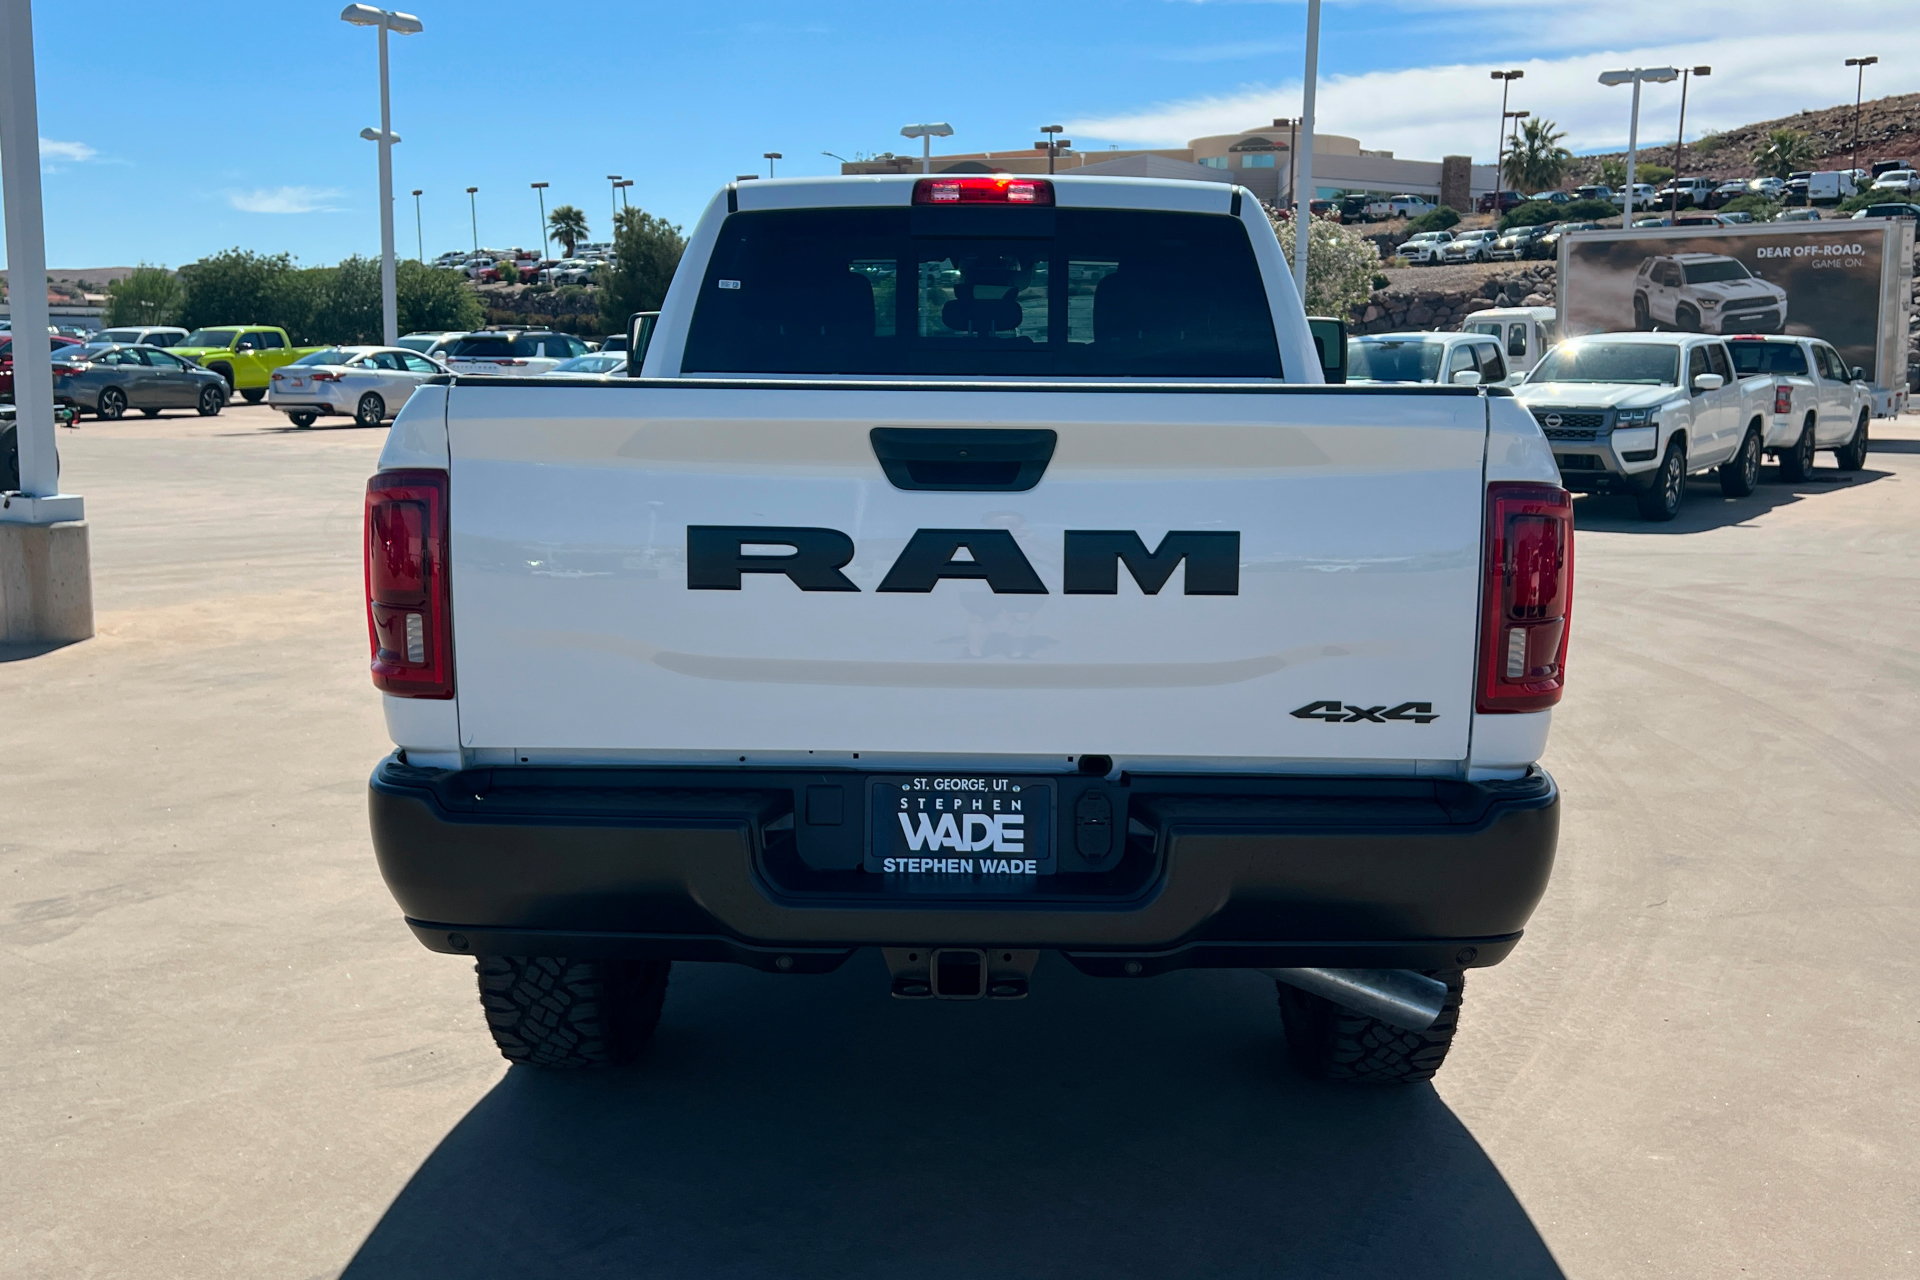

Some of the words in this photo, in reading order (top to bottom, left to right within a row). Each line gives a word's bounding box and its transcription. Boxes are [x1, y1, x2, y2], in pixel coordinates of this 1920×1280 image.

[1757, 247, 1791, 258] DEAR
[1793, 244, 1865, 257] OFF-ROAD,
[1811, 259, 1841, 269] GAME
[687, 525, 1240, 595] RAM
[1289, 700, 1440, 723] 4x4
[913, 778, 930, 790] ST.
[933, 778, 988, 792] GEORGE,
[993, 779, 1008, 791] UT
[900, 798, 1021, 811] STEPHEN
[897, 812, 1024, 852] WADE
[883, 858, 973, 873] STEPHEN
[979, 859, 1037, 874] WADE
